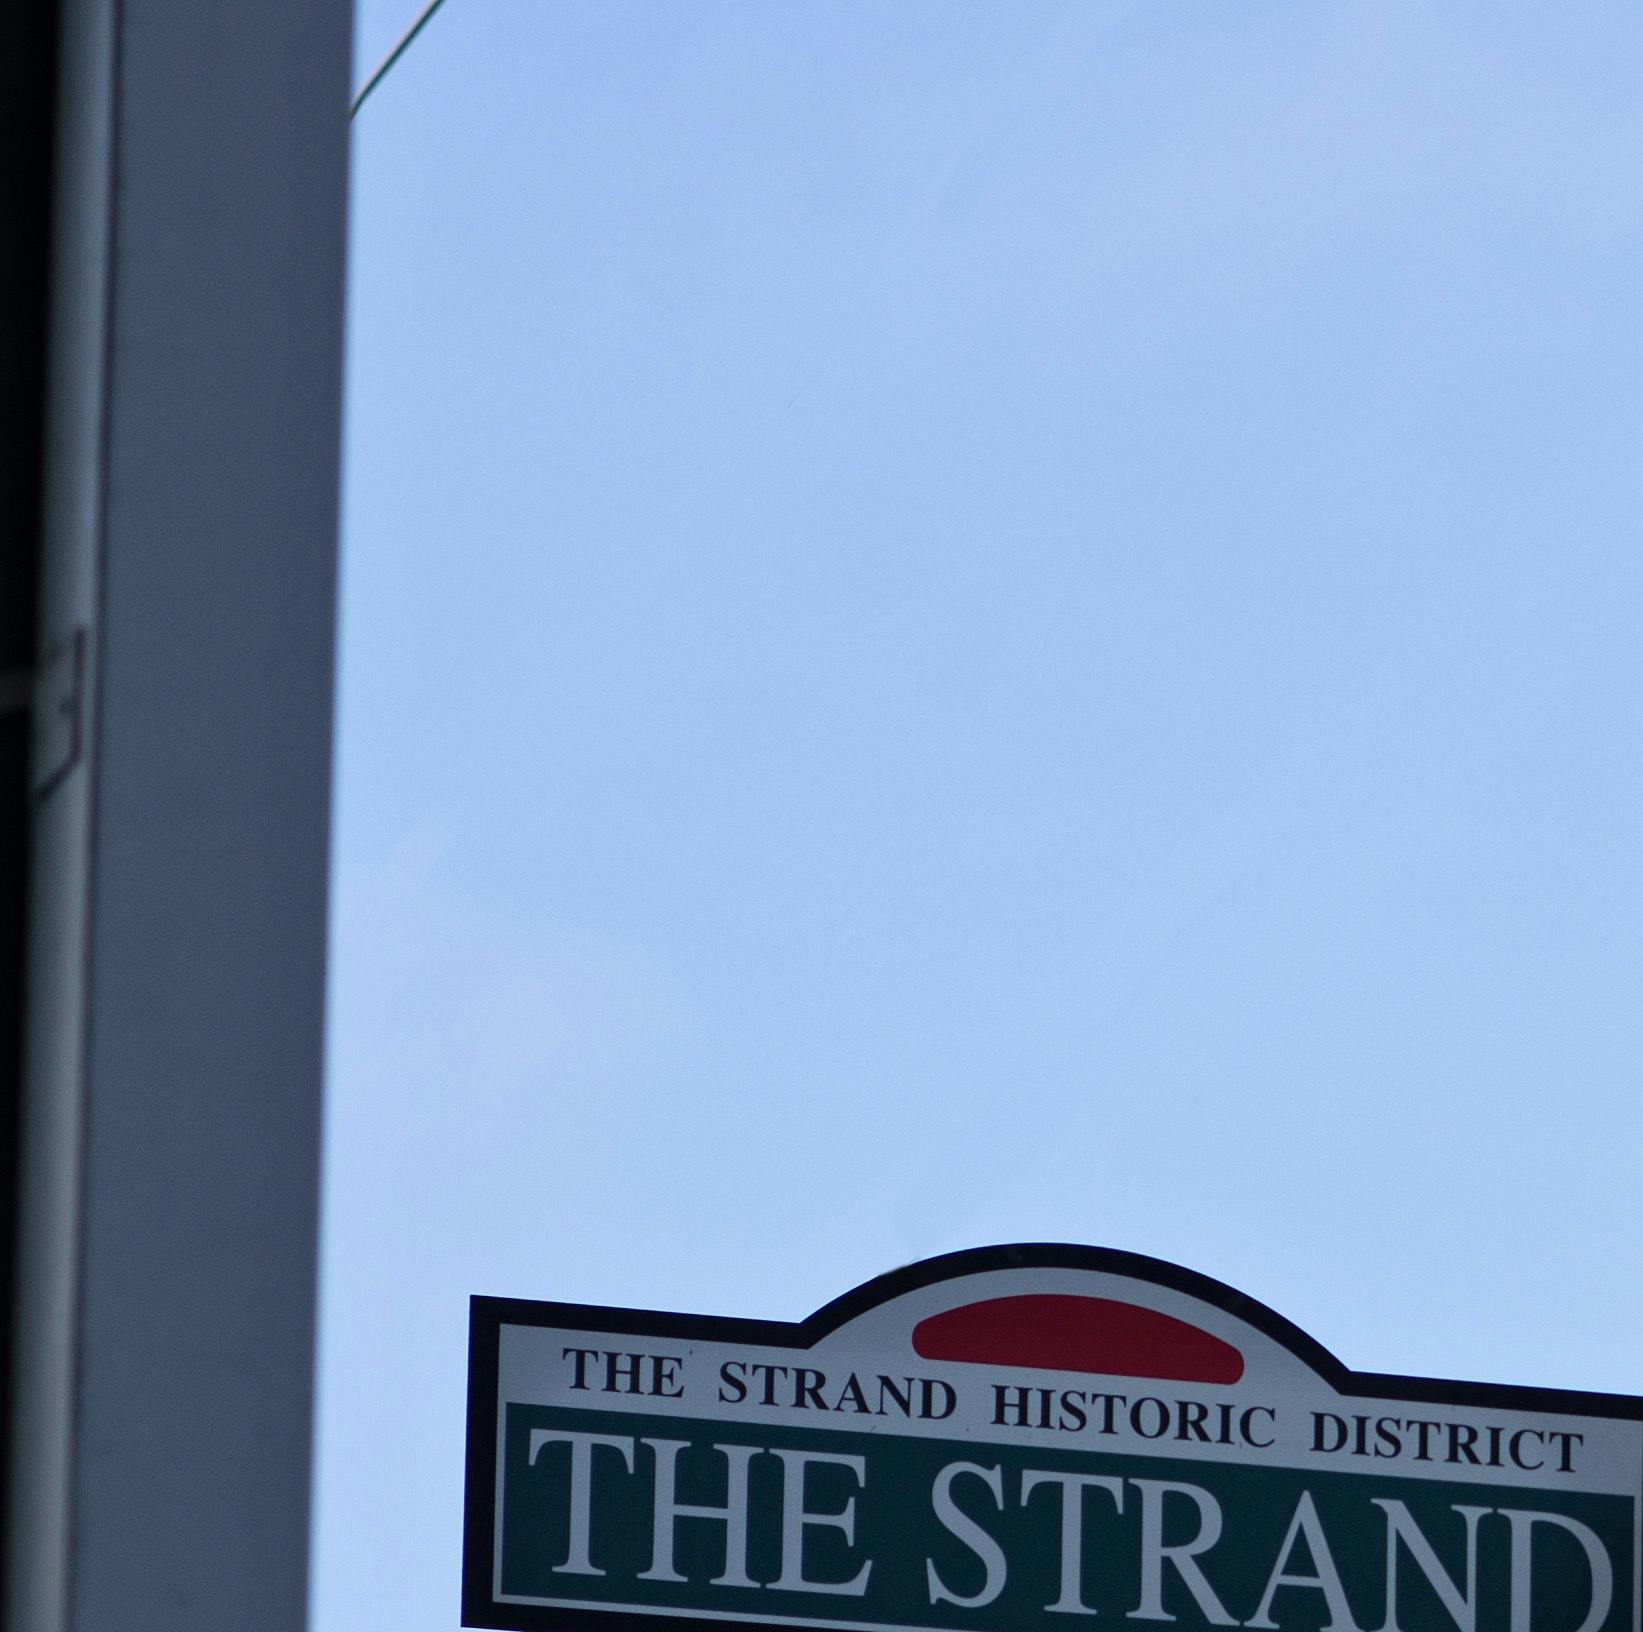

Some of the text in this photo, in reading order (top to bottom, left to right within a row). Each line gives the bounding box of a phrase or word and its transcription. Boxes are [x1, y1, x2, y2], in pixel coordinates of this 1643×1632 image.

[562, 1348, 1583, 1473] THE STRAND HISTORIC DISTRICT
[528, 1428, 873, 1596] THE
